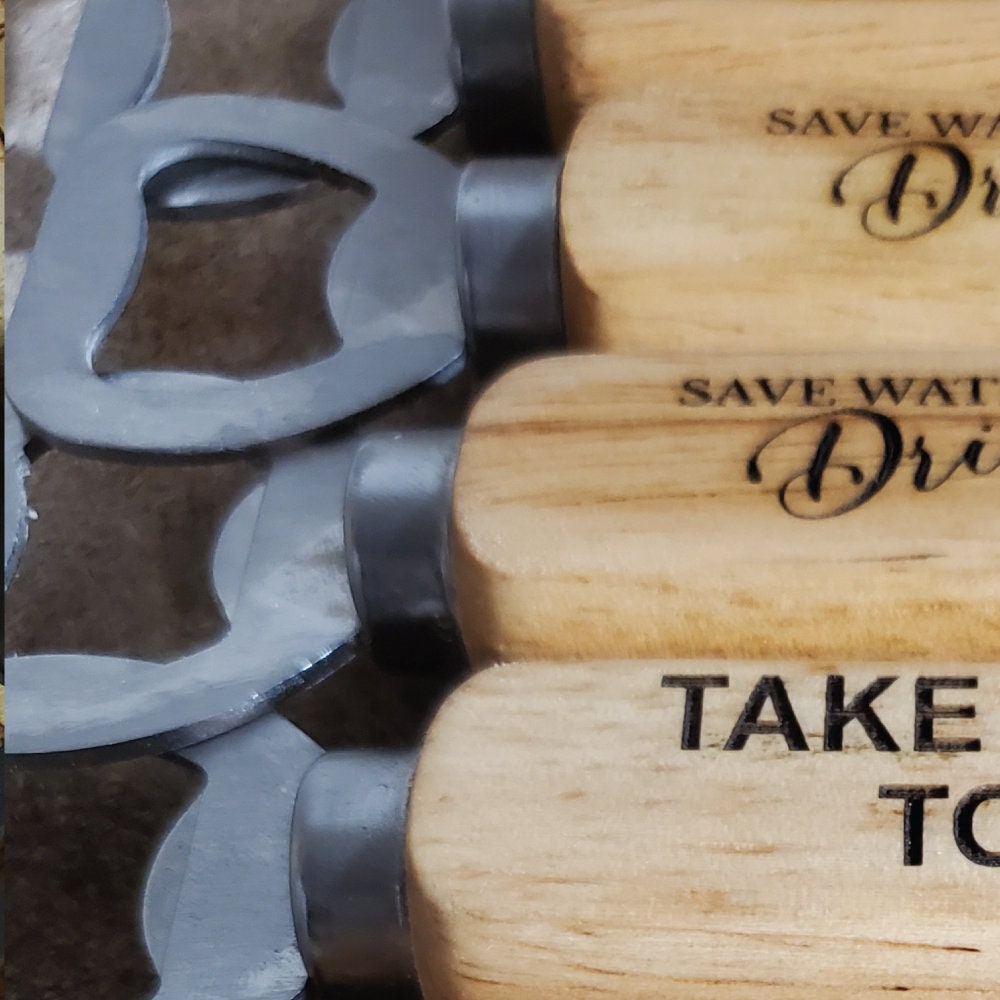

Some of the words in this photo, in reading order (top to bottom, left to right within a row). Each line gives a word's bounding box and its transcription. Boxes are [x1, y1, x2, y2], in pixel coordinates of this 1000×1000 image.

[766, 108, 912, 137] SAVE
[678, 376, 836, 407] SAVE
[660, 674, 981, 754] TAKE
